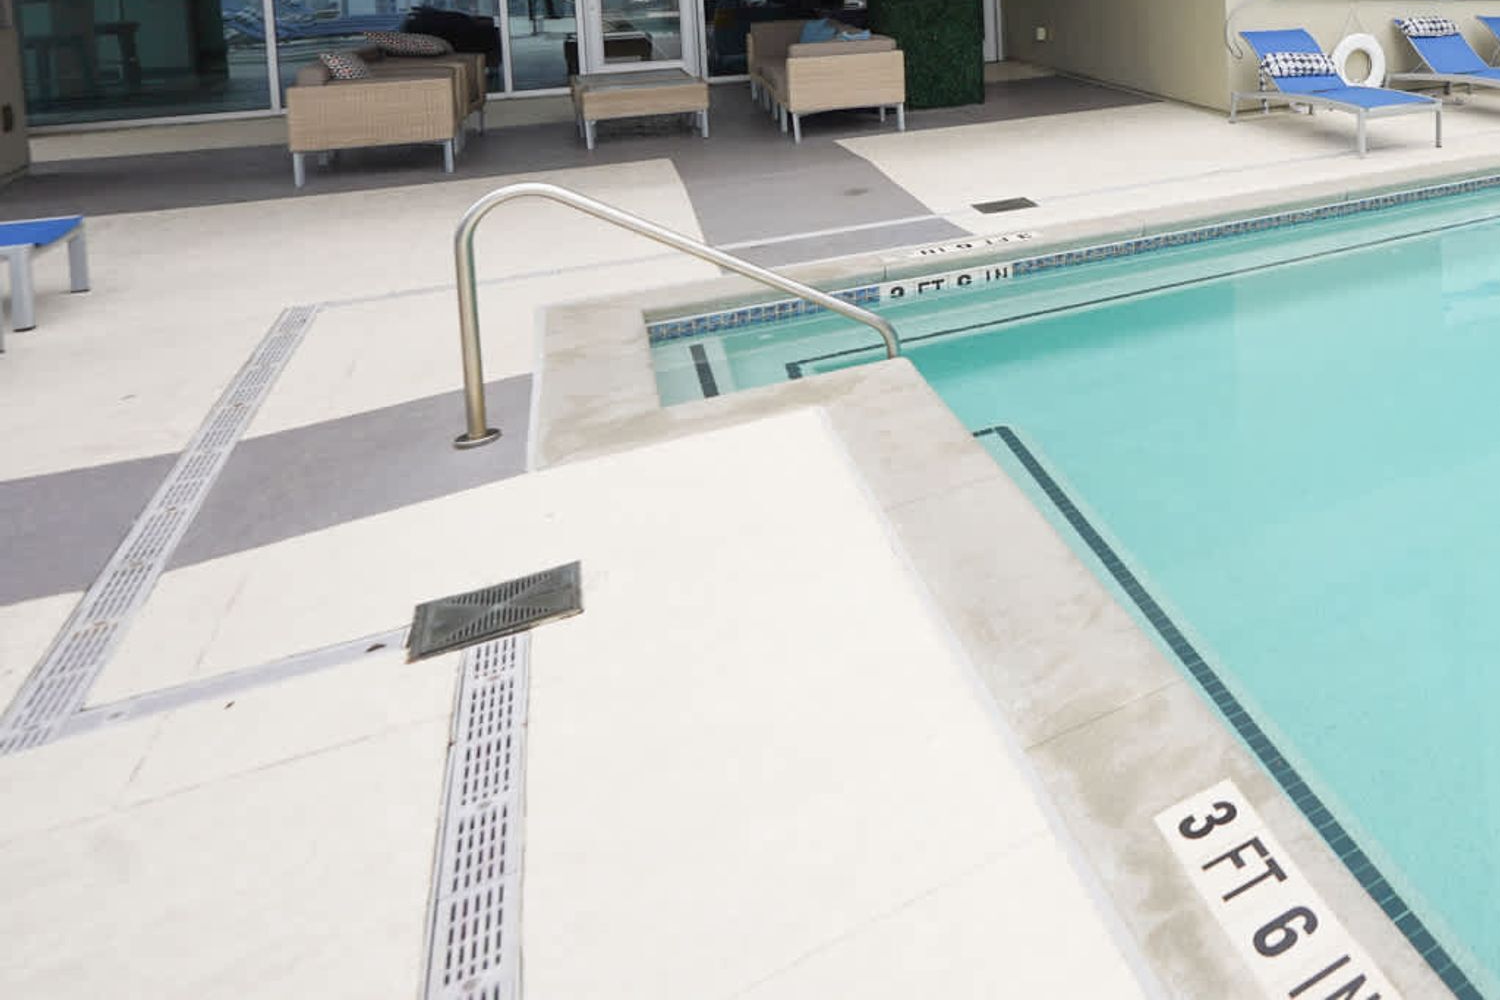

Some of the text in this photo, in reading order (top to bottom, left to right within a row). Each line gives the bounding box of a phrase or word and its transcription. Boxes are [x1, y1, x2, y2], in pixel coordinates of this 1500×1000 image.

[1178, 800, 1238, 840] 3
[1201, 836, 1288, 903] FT
[1252, 905, 1319, 958] 6
